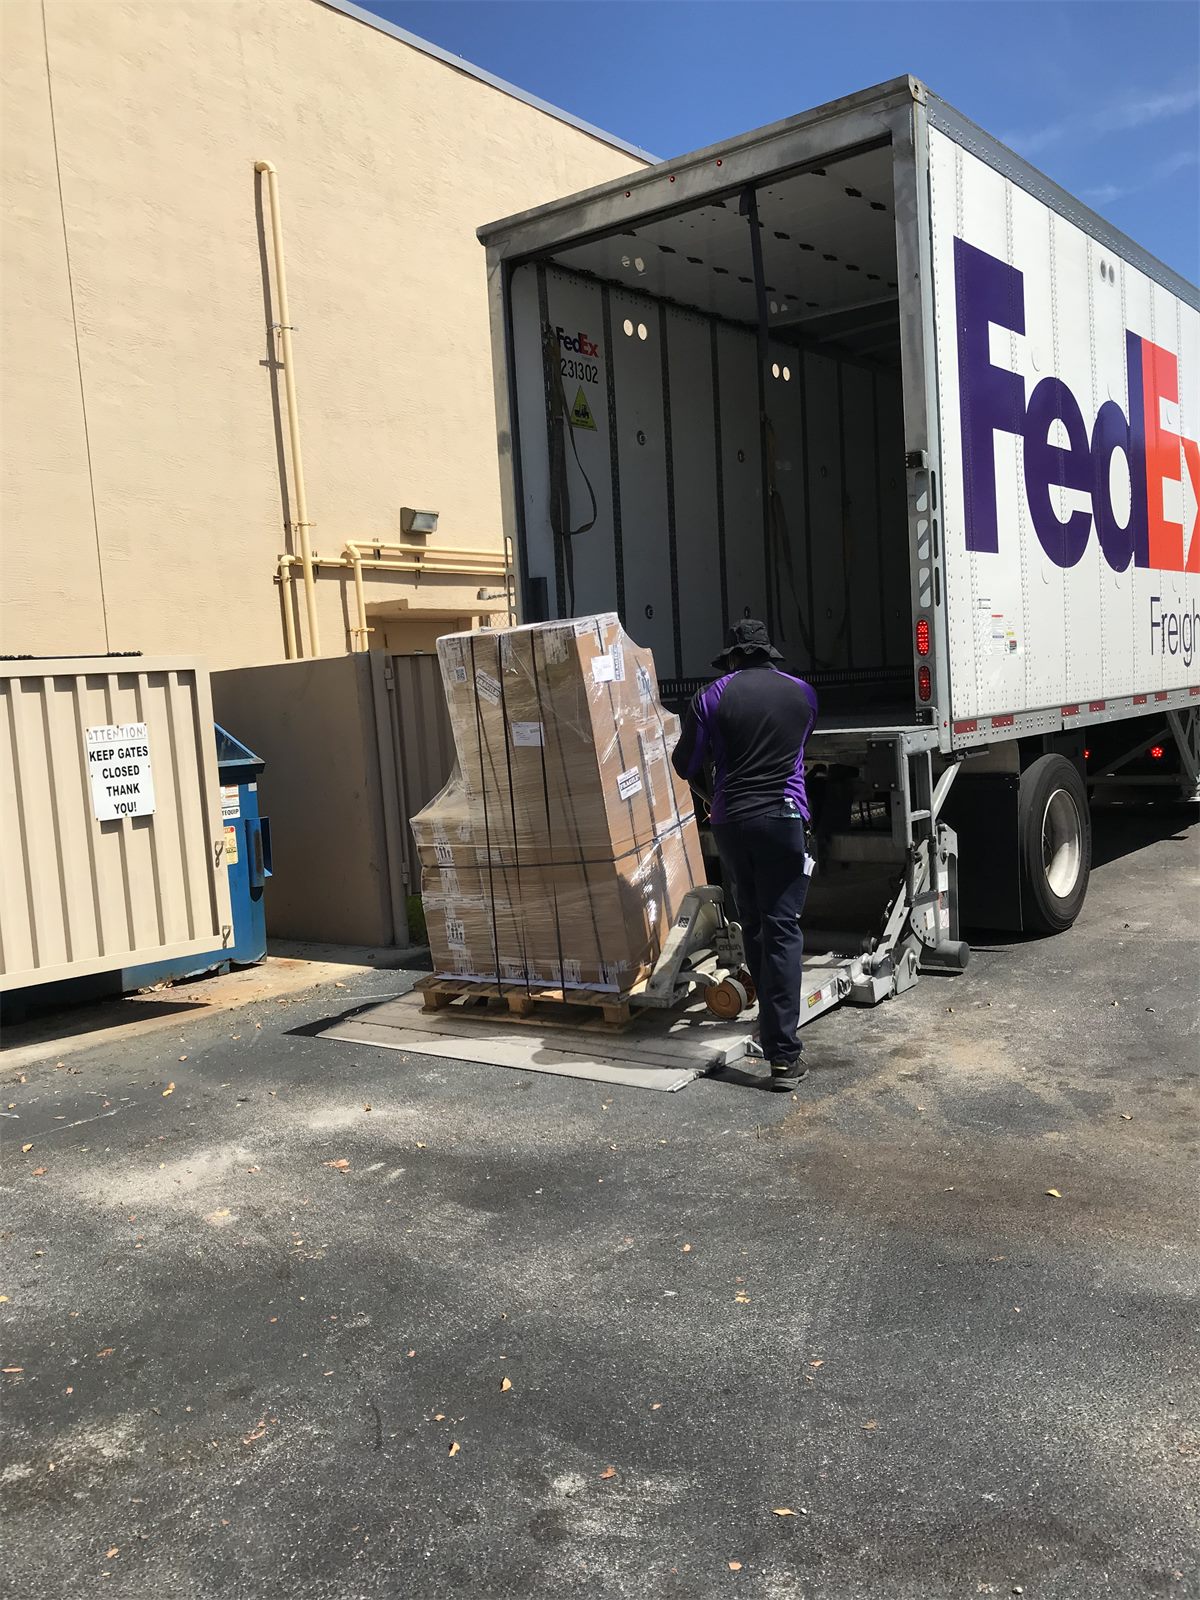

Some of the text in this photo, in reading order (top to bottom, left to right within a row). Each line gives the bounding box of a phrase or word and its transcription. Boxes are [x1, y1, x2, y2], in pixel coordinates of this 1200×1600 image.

[556, 326, 599, 358] FedEx
[561, 358, 599, 384] 231302
[1150, 596, 1200, 668] Freigh
[88, 726, 147, 741] ATTENTION!
[89, 745, 149, 762] KEEP GATES
[102, 765, 140, 779] CLOSED
[106, 783, 140, 797] THANK
[114, 801, 137, 814] YOU!
[222, 808, 239, 816] TEQUIP
